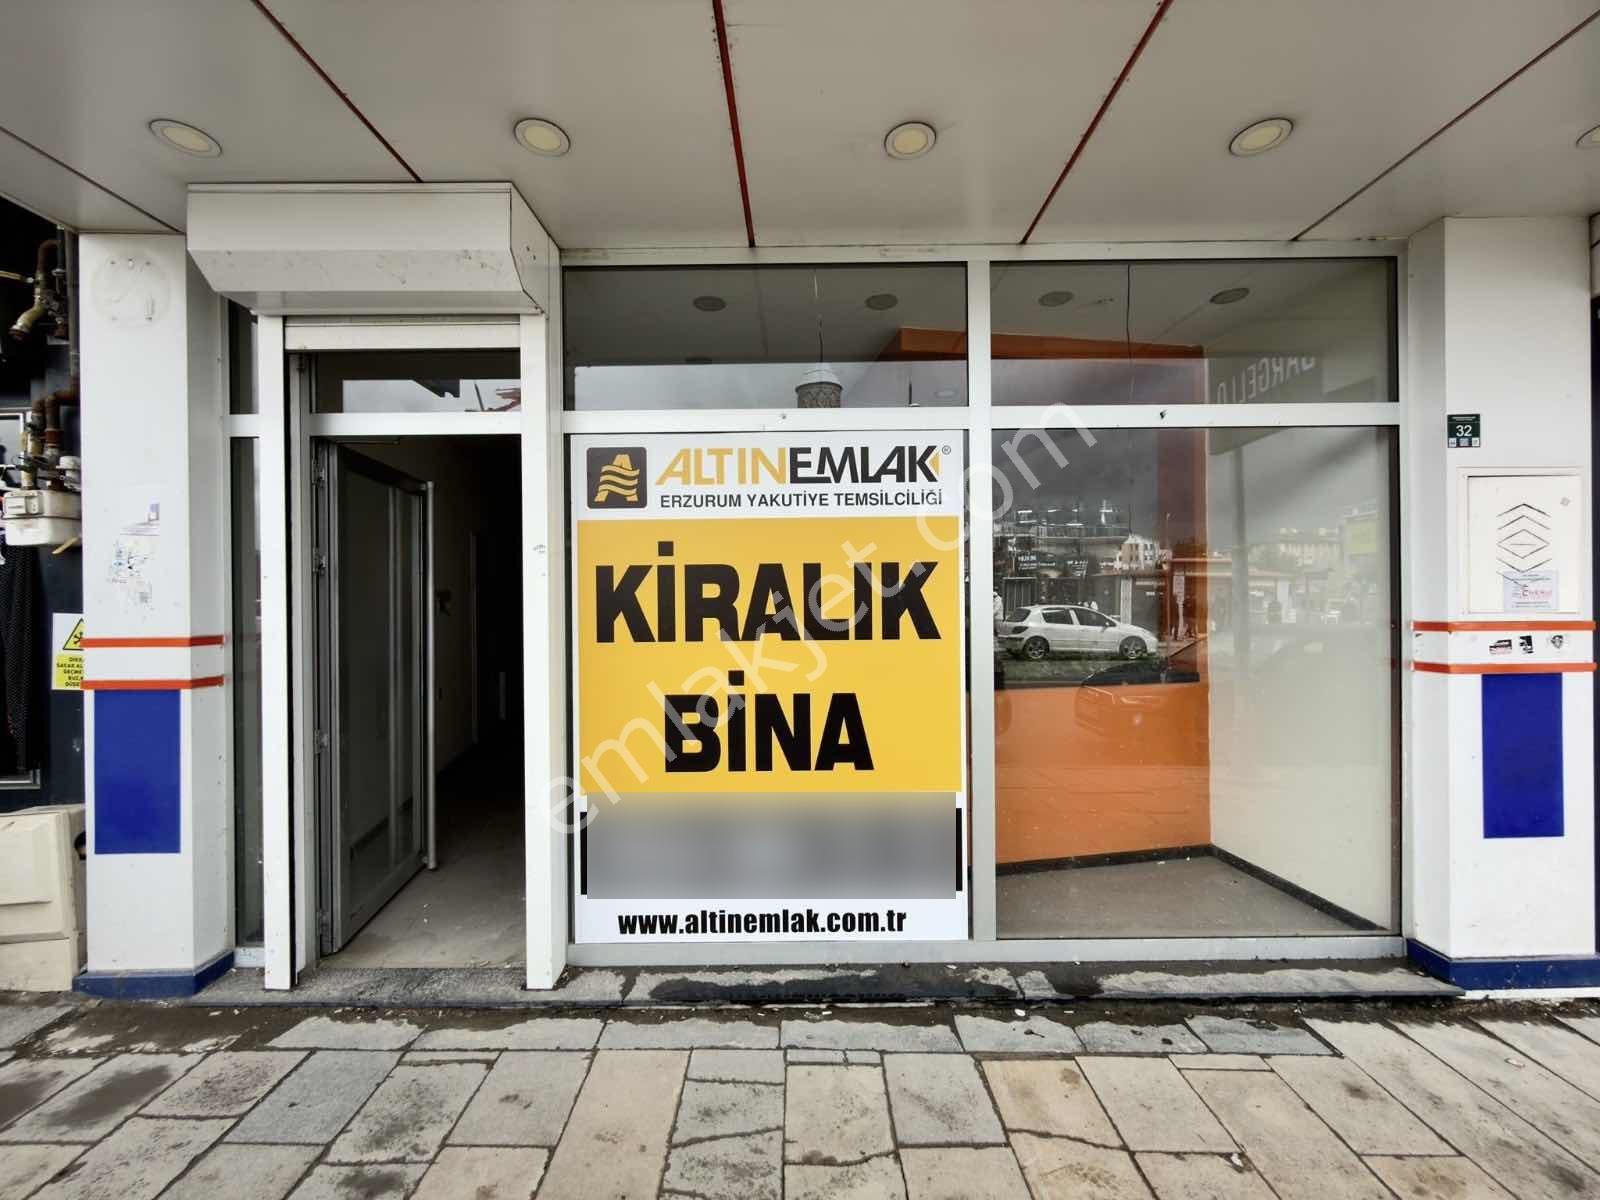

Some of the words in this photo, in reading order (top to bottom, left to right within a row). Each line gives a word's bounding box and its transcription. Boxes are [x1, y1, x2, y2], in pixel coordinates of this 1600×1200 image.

[1456, 424, 1473, 437] 32
[660, 494, 742, 509] ERZURUM
[747, 490, 830, 508] YAKUTİYE
[834, 488, 943, 507] TEMSİLCİLİĞİ
[595, 541, 942, 643] KİRALIK
[664, 670, 875, 773] BİNA
[618, 908, 907, 935] www.altinemlak.com.tr
